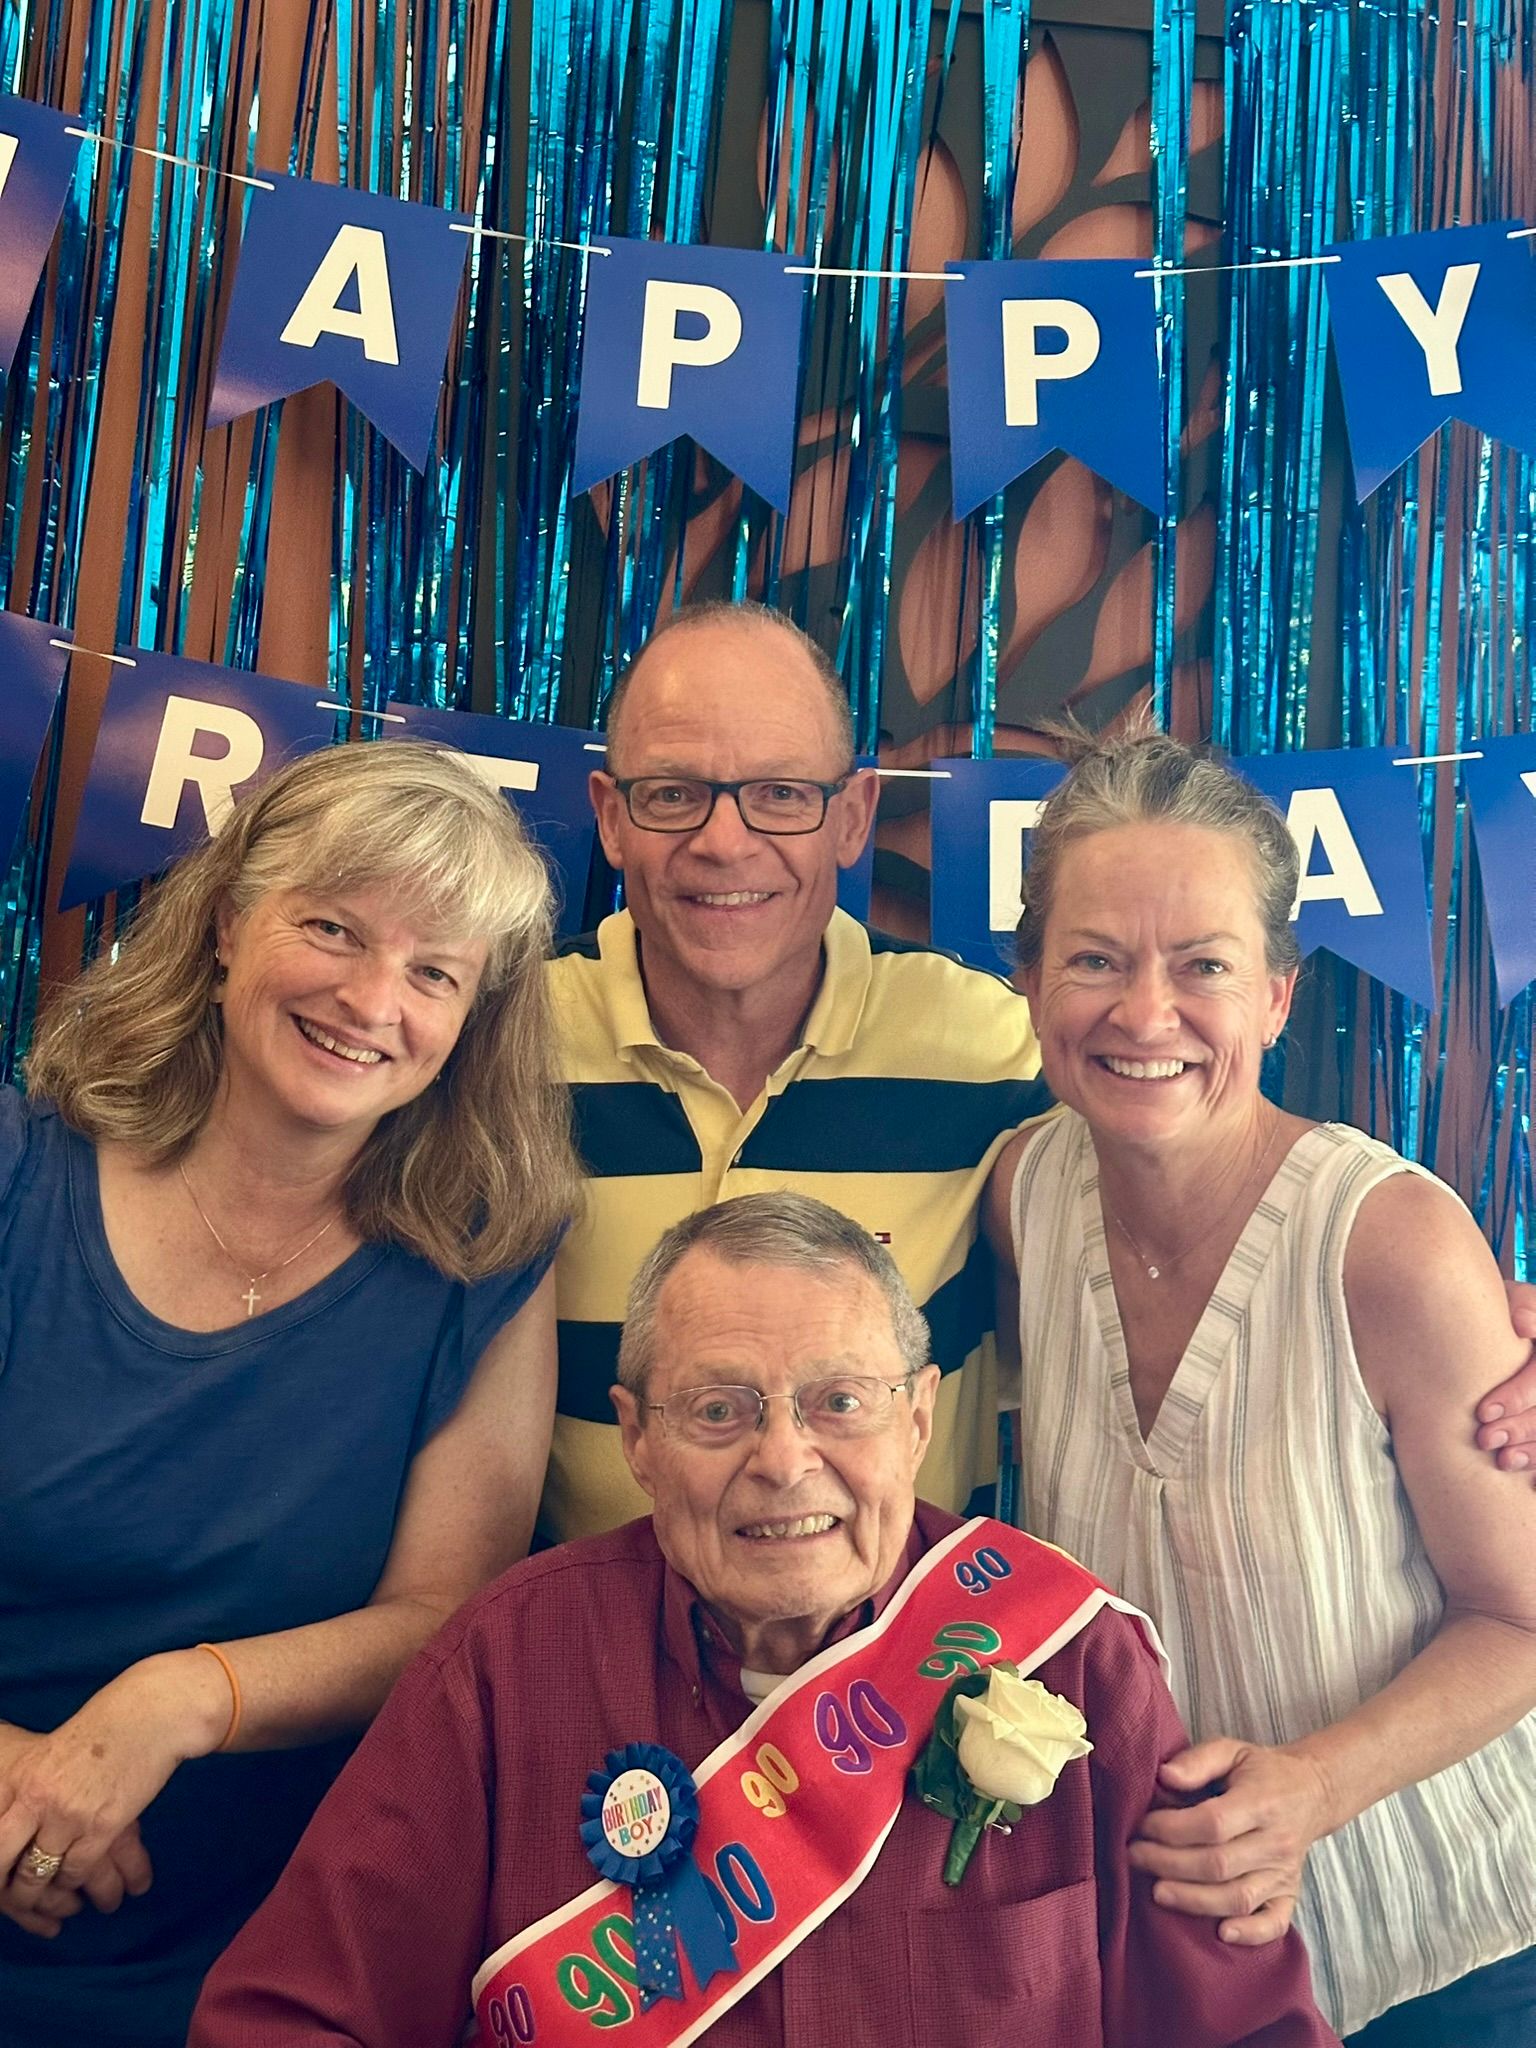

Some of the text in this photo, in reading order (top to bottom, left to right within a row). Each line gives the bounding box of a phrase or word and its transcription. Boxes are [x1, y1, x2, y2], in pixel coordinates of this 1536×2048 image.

[0, 132, 1480, 426] APPY
[954, 1546, 1013, 1596] 90
[917, 1621, 1001, 1680] 90
[814, 1679, 908, 1775] 90
[603, 1786, 662, 1832] BIRTHDAY
[741, 1742, 799, 1818] 90
[619, 1816, 653, 1846] BOY
[556, 1912, 638, 2029] 90
